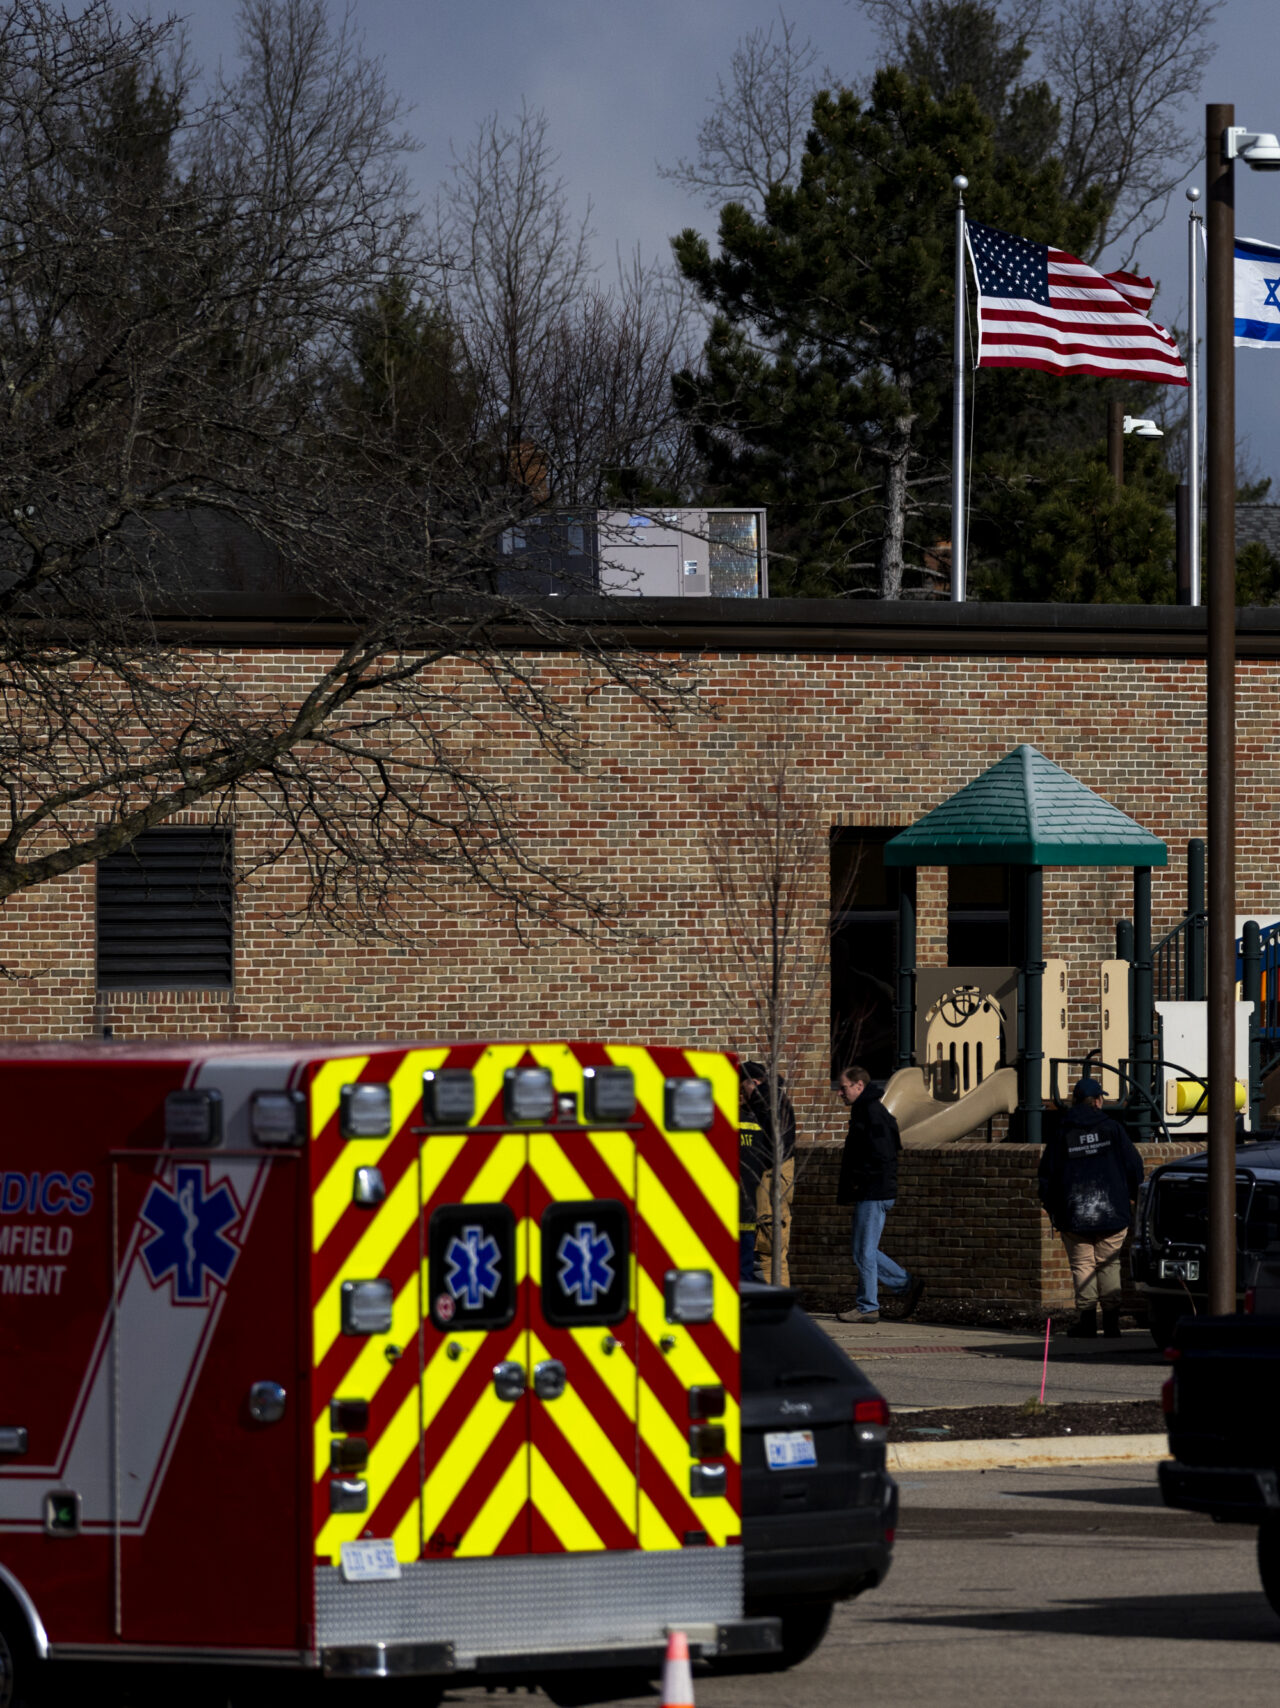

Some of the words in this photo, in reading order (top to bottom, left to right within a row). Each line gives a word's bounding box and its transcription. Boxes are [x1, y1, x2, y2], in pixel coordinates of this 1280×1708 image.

[1079, 1133, 1099, 1144] FBI
[0, 1169, 95, 1216] DICS
[780, 1399, 813, 1417] Jeep
